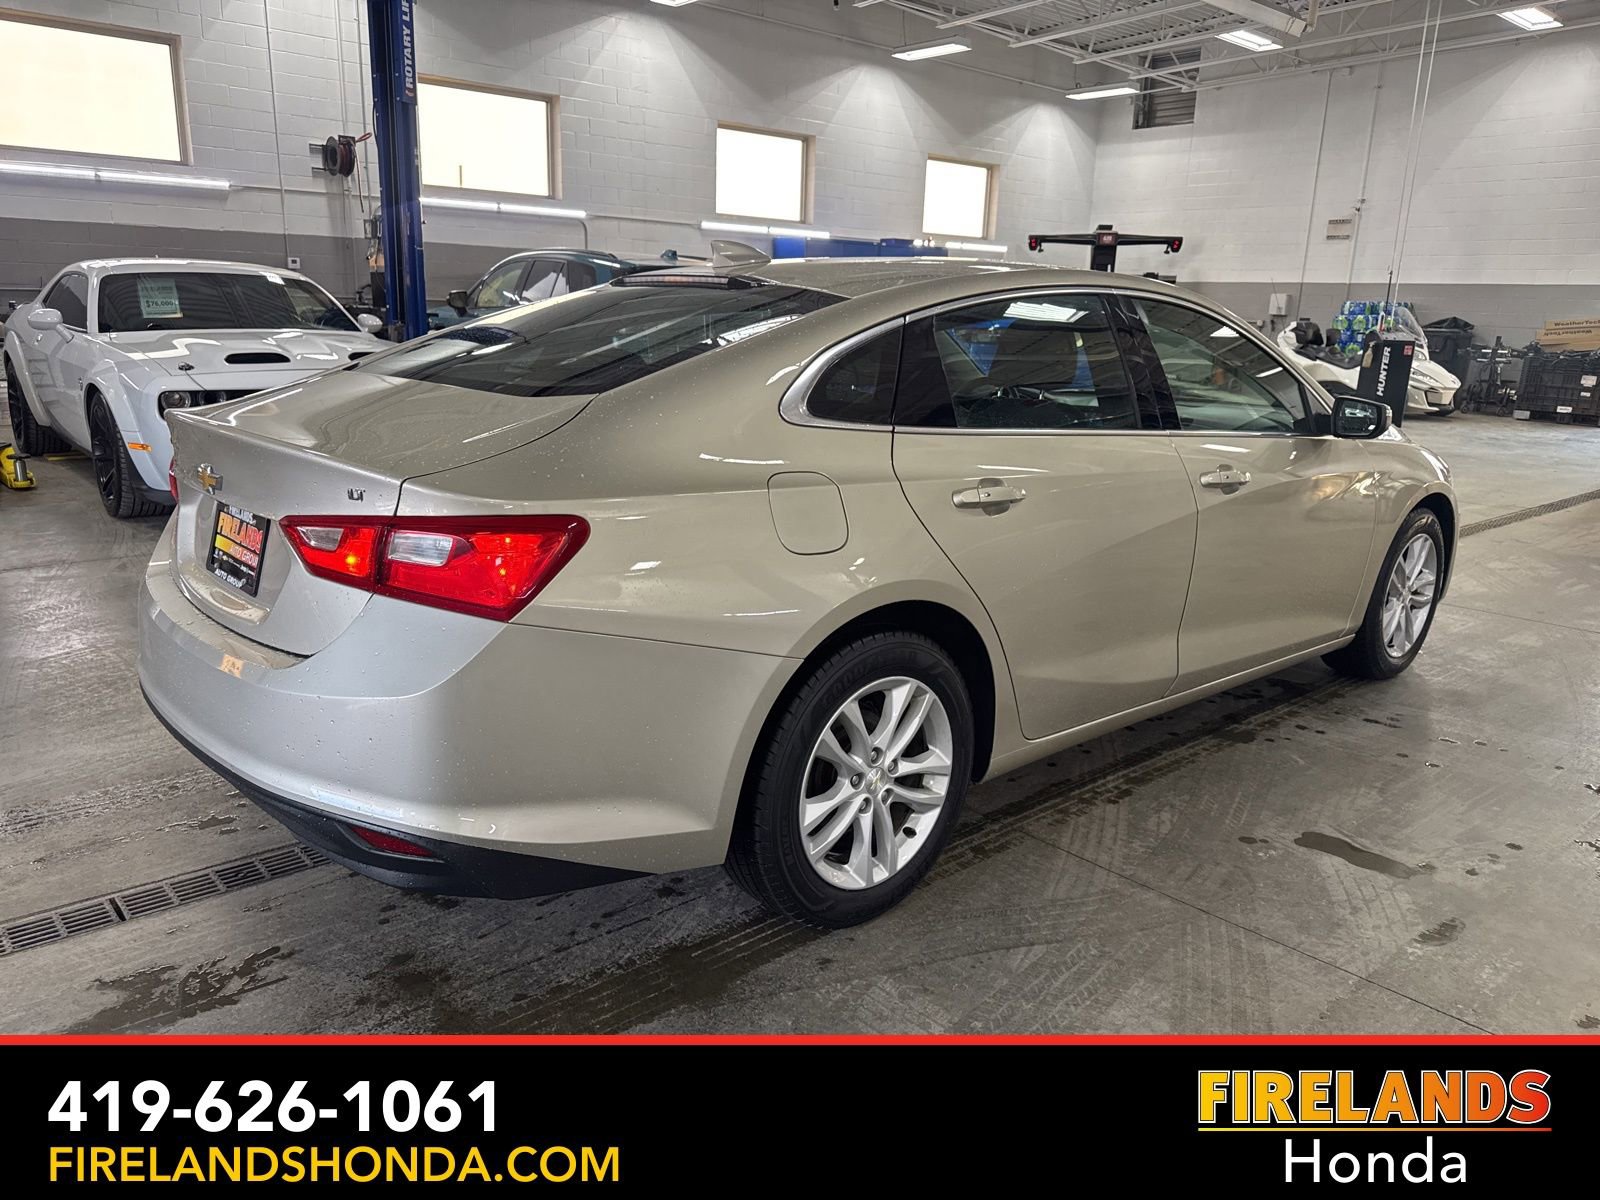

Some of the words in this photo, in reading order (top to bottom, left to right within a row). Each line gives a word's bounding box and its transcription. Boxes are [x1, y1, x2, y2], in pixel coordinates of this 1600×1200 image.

[402, 25, 413, 89] ROTARY
[1376, 346, 1391, 397] HUNTER
[217, 511, 263, 553] FIRELANDS
[214, 568, 228, 580] AUTO
